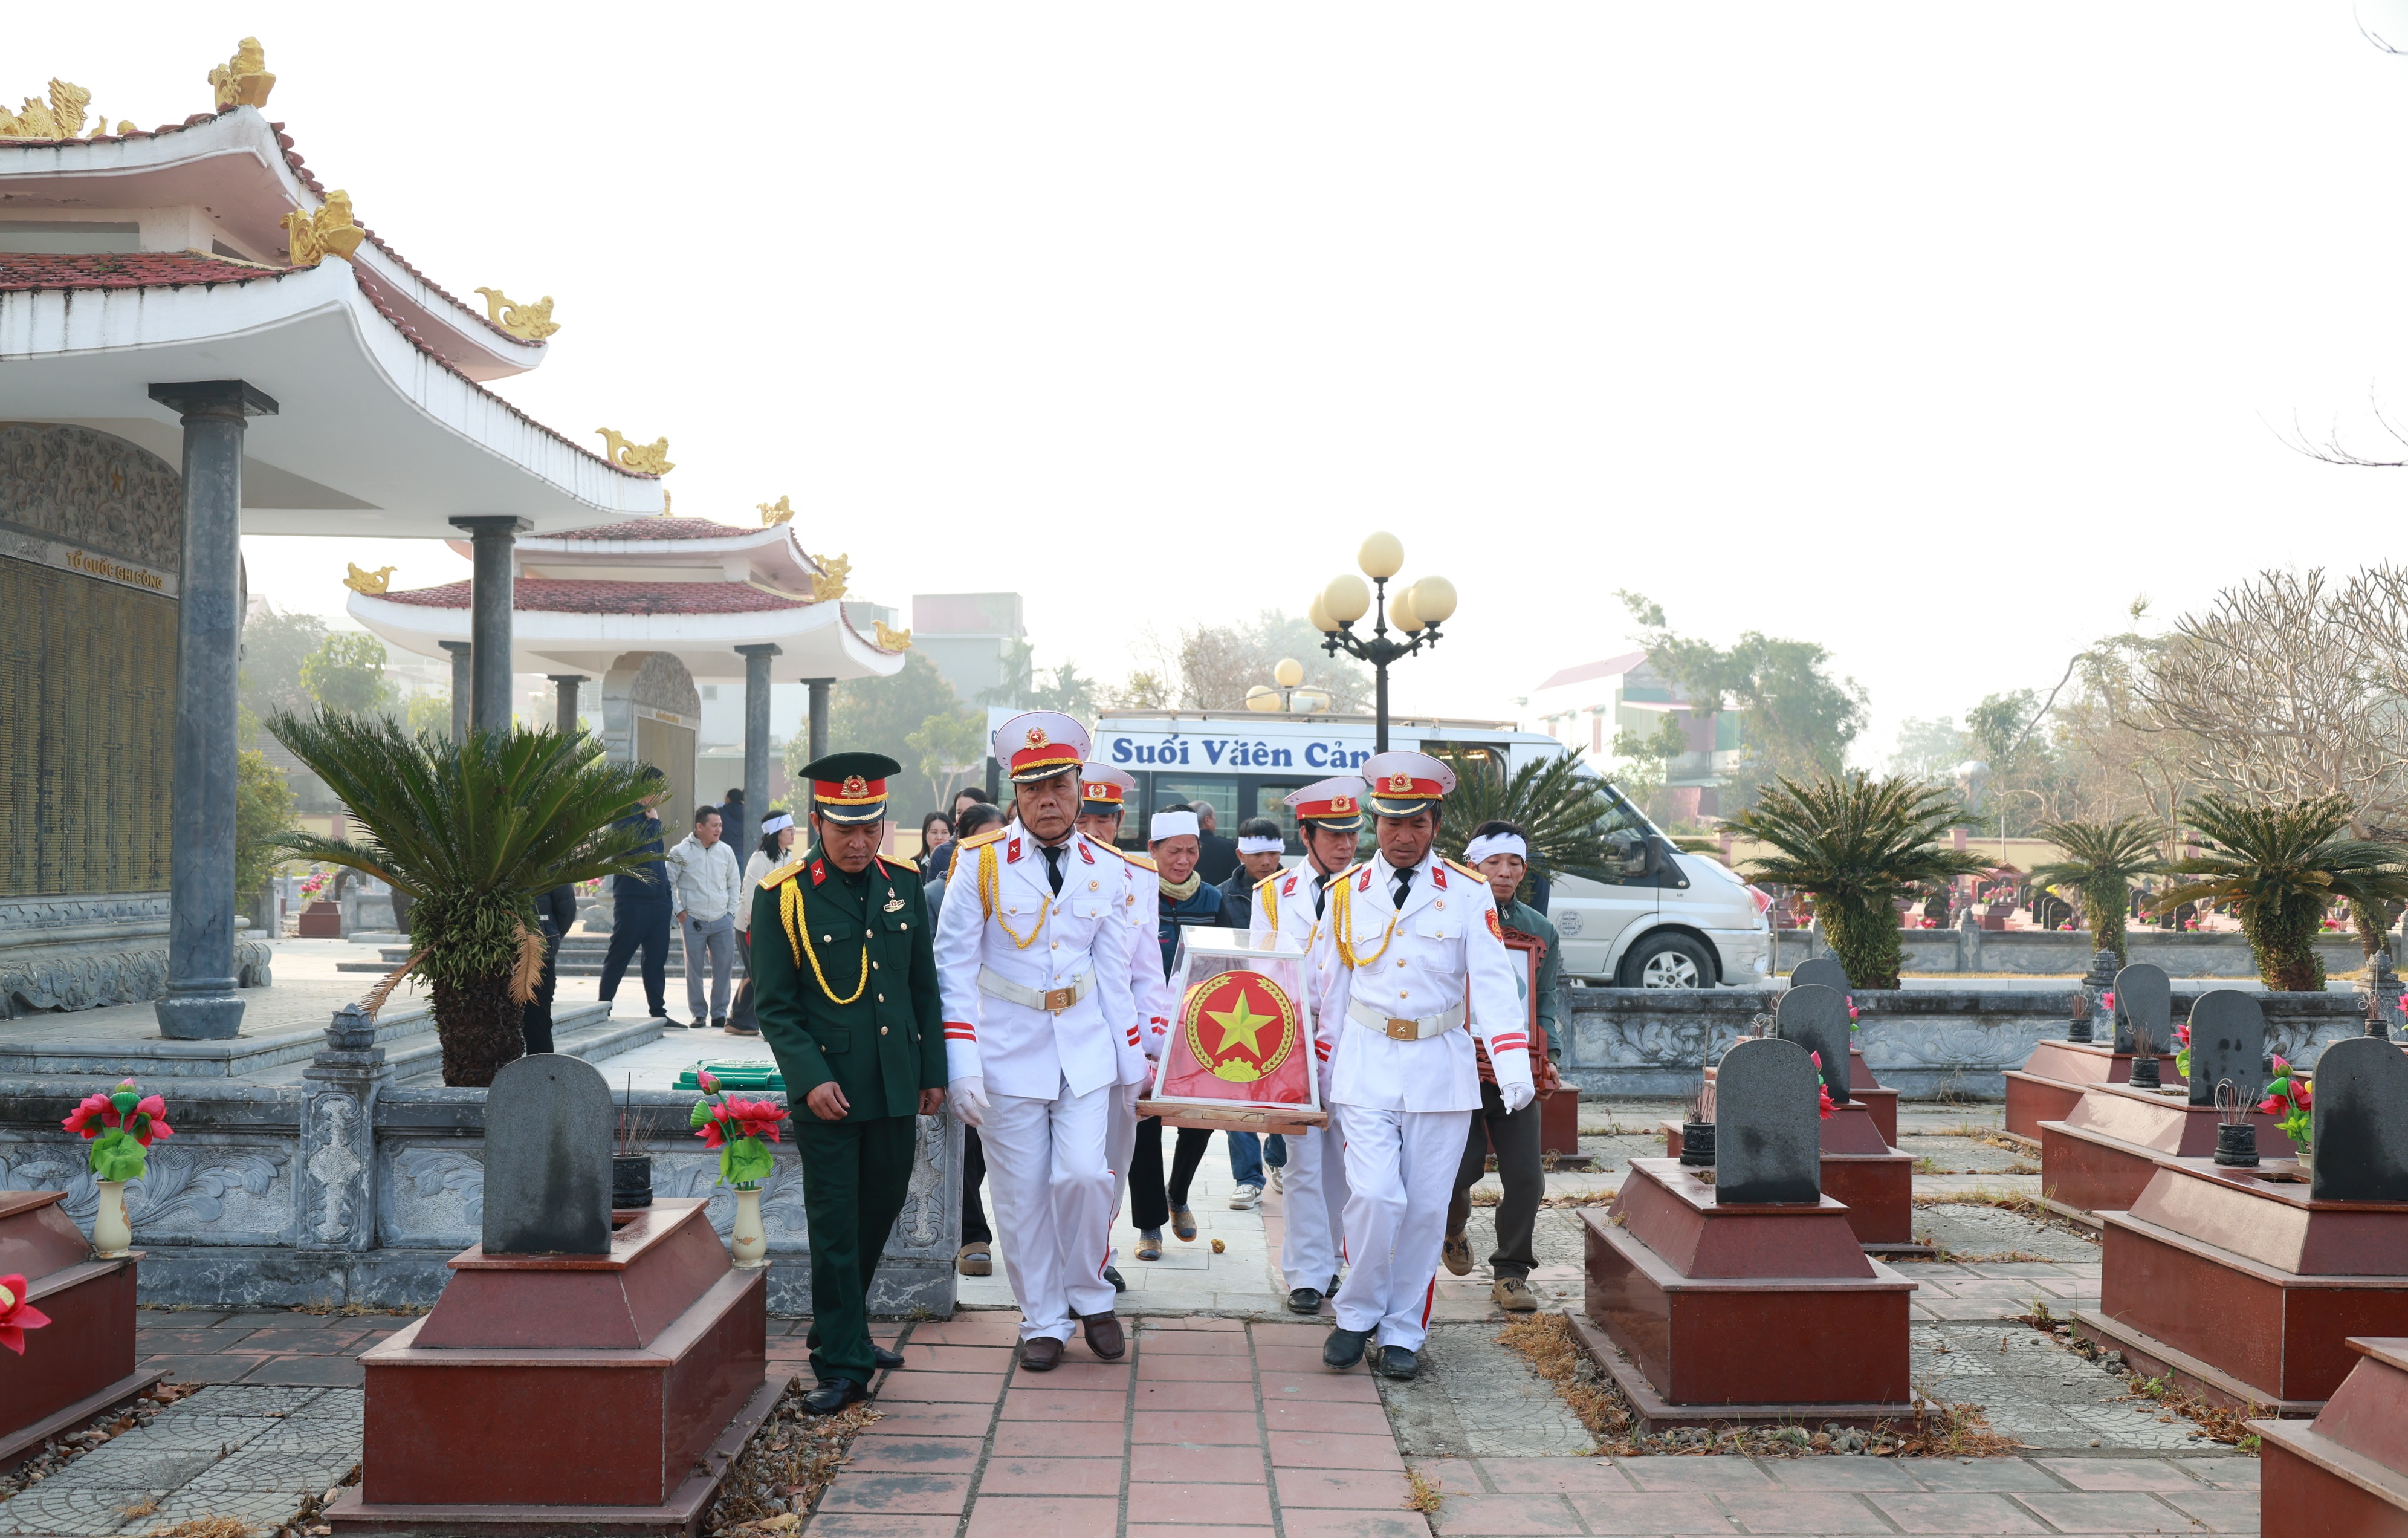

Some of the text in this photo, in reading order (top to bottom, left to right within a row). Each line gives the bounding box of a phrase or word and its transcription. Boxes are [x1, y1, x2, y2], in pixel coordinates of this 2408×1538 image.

[66, 550, 163, 589] TỔ QUỐC GHI CÔNG
[1112, 734, 1190, 764] Suối
[1304, 741, 1377, 769] Cản
